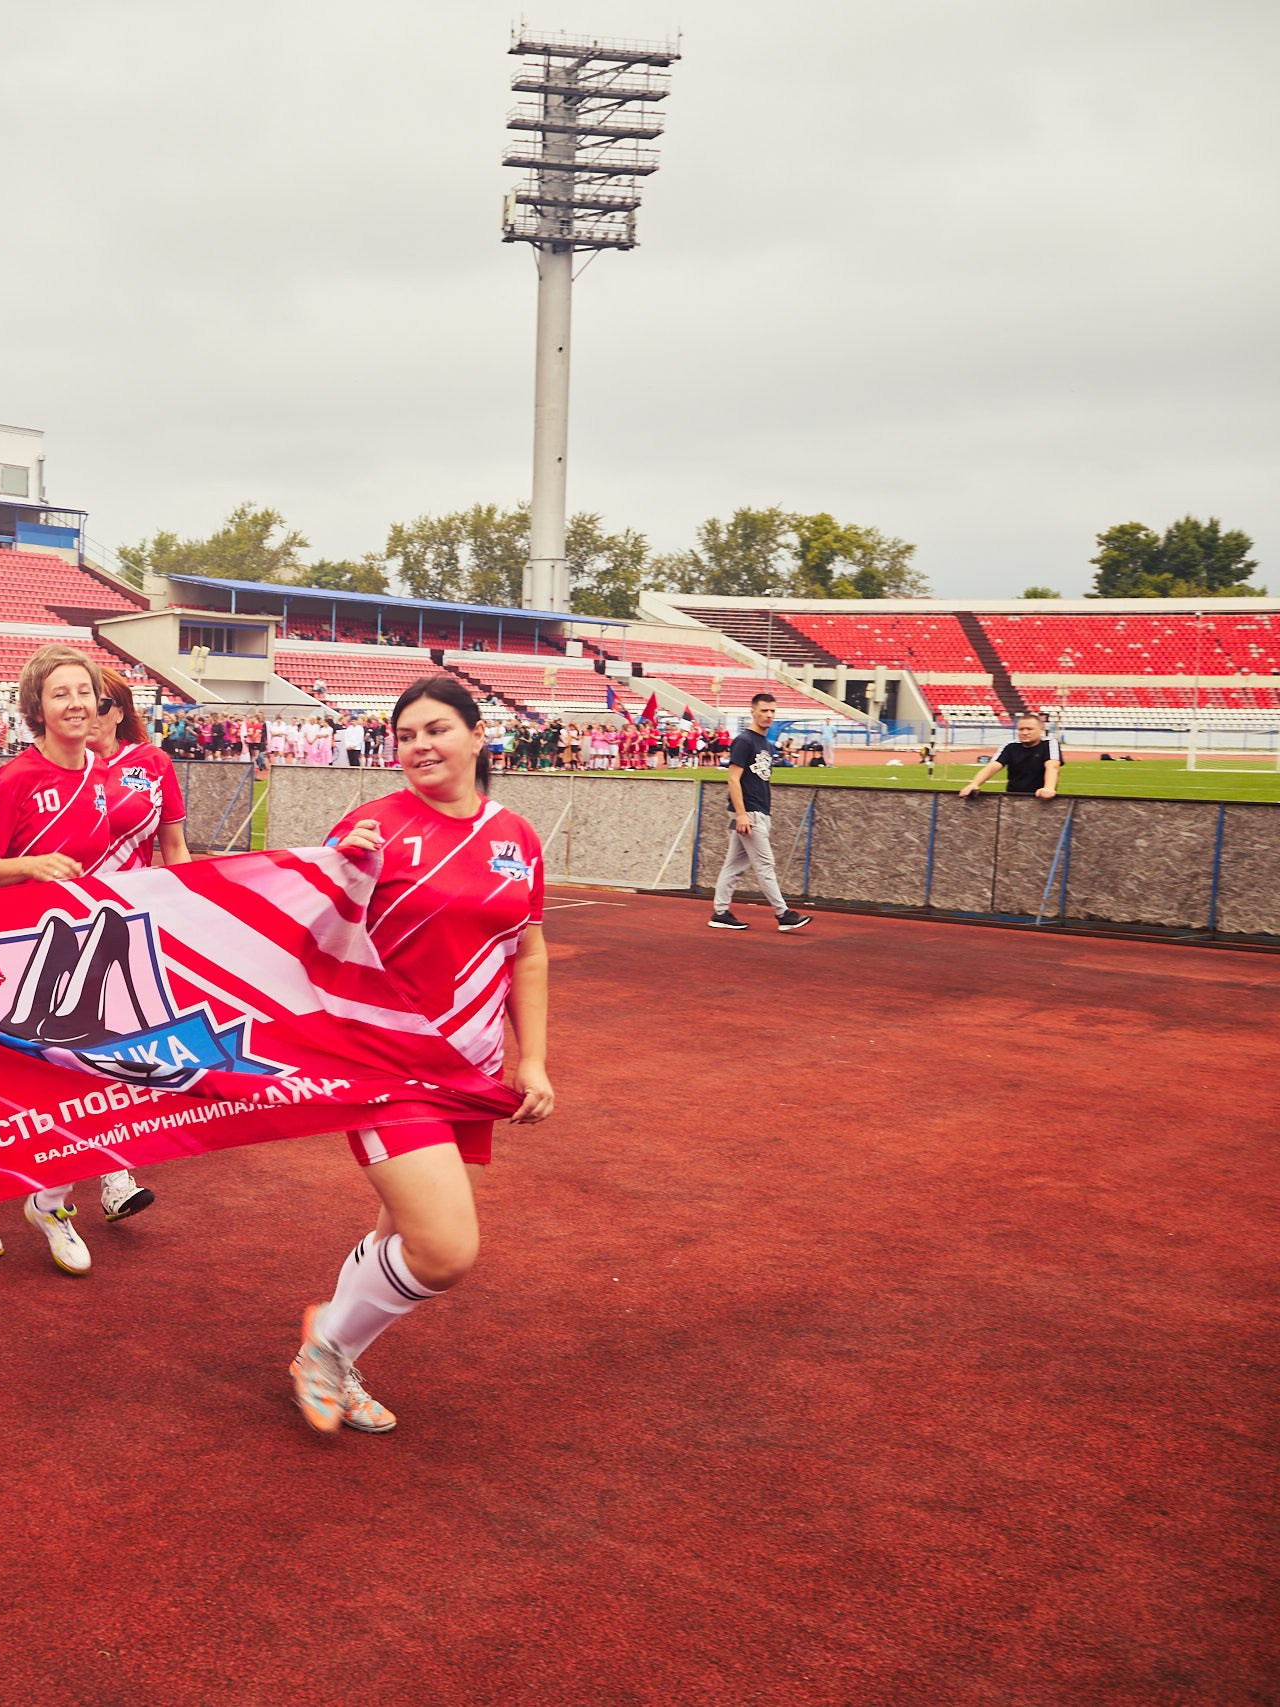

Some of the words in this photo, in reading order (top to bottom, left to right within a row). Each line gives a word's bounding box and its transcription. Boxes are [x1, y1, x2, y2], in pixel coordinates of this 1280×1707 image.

[32, 788, 61, 814] 10
[403, 835, 422, 867] 7
[33, 1122, 131, 1164] ВАДСКИЙ
